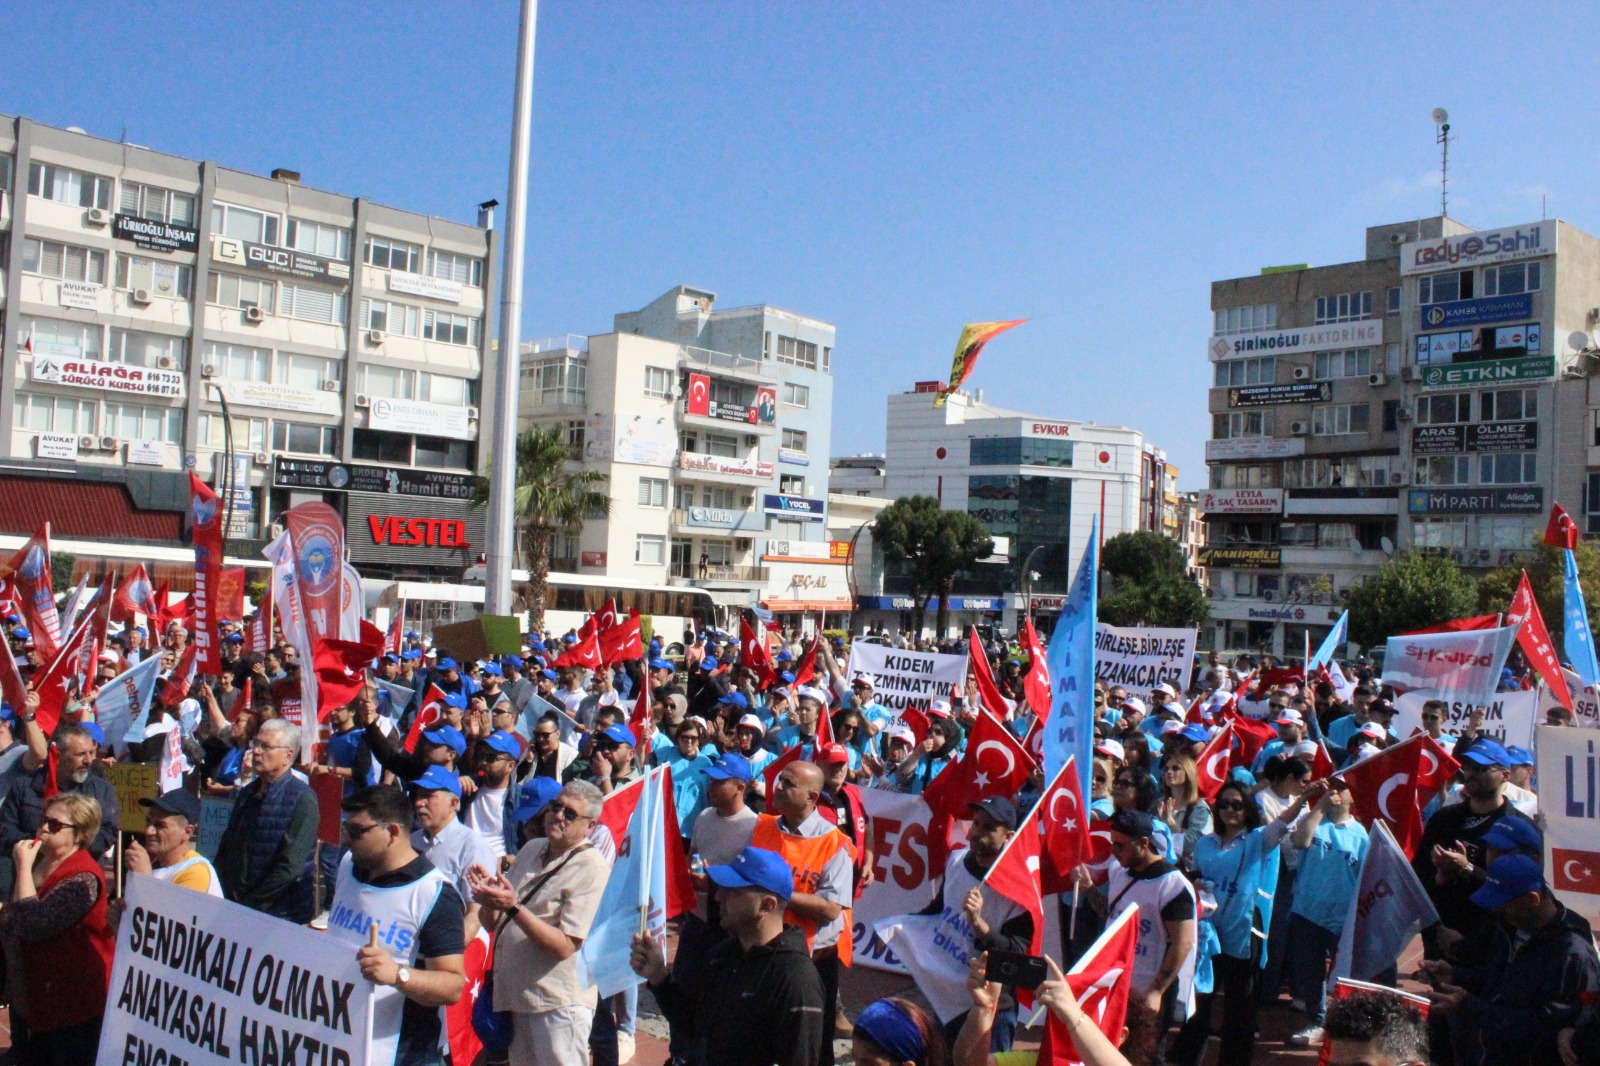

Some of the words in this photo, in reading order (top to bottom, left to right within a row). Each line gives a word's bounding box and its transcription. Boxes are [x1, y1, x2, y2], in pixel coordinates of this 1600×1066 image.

[165, 224, 196, 242] İNŞAAT
[1485, 226, 1541, 255] Sahil
[249, 246, 288, 266] GÜÇ
[63, 282, 97, 293] AVUKAT
[1234, 333, 1300, 355] ŞİRİNOĞLU
[1302, 326, 1375, 346] FAKTORİNG
[62, 362, 143, 381] ALİAĞA
[147, 372, 160, 382] 616
[162, 374, 171, 383] 73
[172, 375, 180, 384] 33
[1446, 362, 1516, 382] ETKİN
[61, 374, 105, 386] SÜRÜCÜ
[108, 380, 144, 392] KURSU
[412, 407, 438, 417] ORHAN
[1032, 423, 1070, 436] EVKUR
[1420, 428, 1456, 436] ARAS
[1477, 424, 1526, 434] ÖLMEZ
[352, 468, 383, 478] ERDEM
[425, 474, 464, 484] AVUKAT
[401, 481, 440, 495] Hamit
[1218, 499, 1234, 507] SAÇ
[1430, 494, 1447, 509] İYİ
[1450, 494, 1494, 509] PARTİ
[1506, 493, 1535, 502] Aliağa
[788, 500, 811, 510] YÜCEL
[704, 510, 732, 523] Milda
[368, 515, 466, 547] VESTEL
[1031, 598, 1062, 608] EVKUR
[884, 655, 934, 674] KIDEM
[1095, 660, 1182, 686] AZANACAĞIZ
[130, 906, 252, 997] SENDİKALI
[252, 954, 354, 1036] OLMAK
[118, 965, 230, 1060] ANAYASAL
[240, 1014, 351, 1066] HAKTIR
